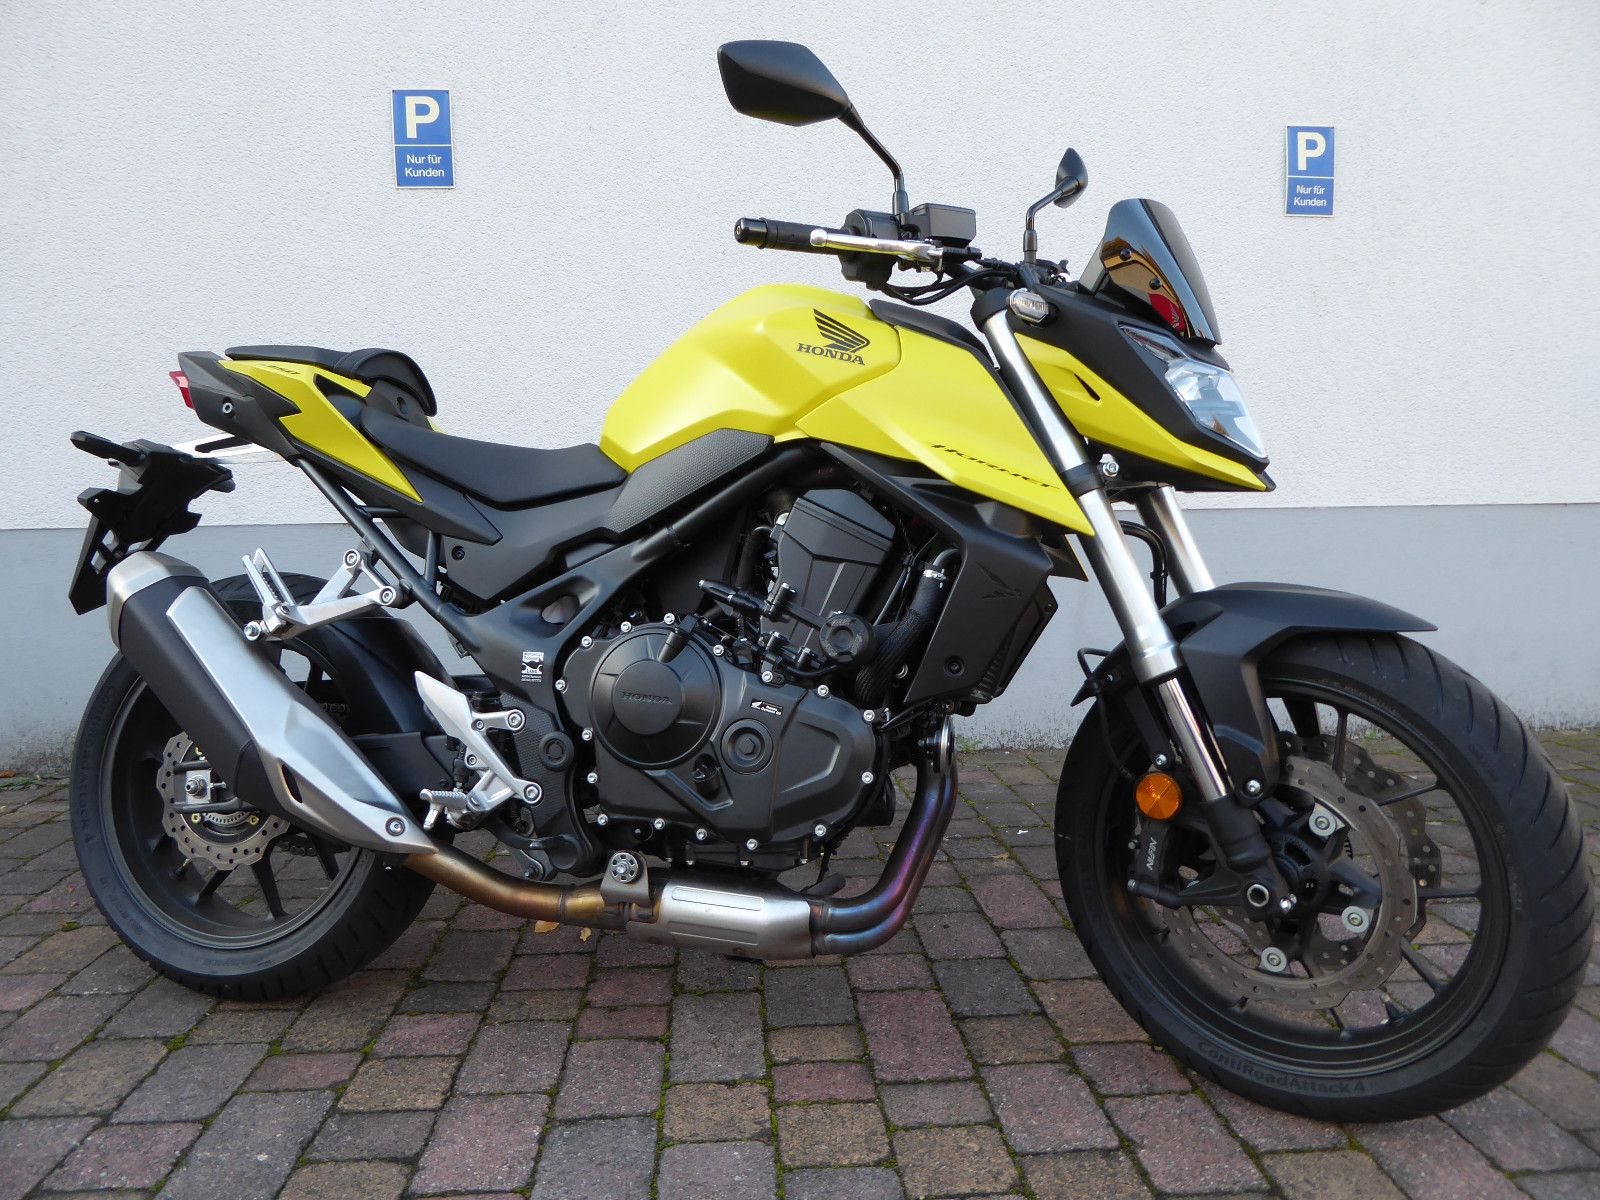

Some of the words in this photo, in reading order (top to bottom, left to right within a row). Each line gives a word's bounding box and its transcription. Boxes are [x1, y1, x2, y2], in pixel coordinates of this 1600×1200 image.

[404, 95, 440, 139] P
[1297, 131, 1327, 171] P
[406, 154, 426, 164] Nur
[427, 154, 442, 164] für
[404, 167, 445, 177] Kunden
[1296, 184, 1311, 194] Nur
[1313, 185, 1326, 195] für
[1293, 196, 1327, 207] Kunden
[796, 342, 866, 366] HONDA
[622, 690, 674, 706] HONDA
